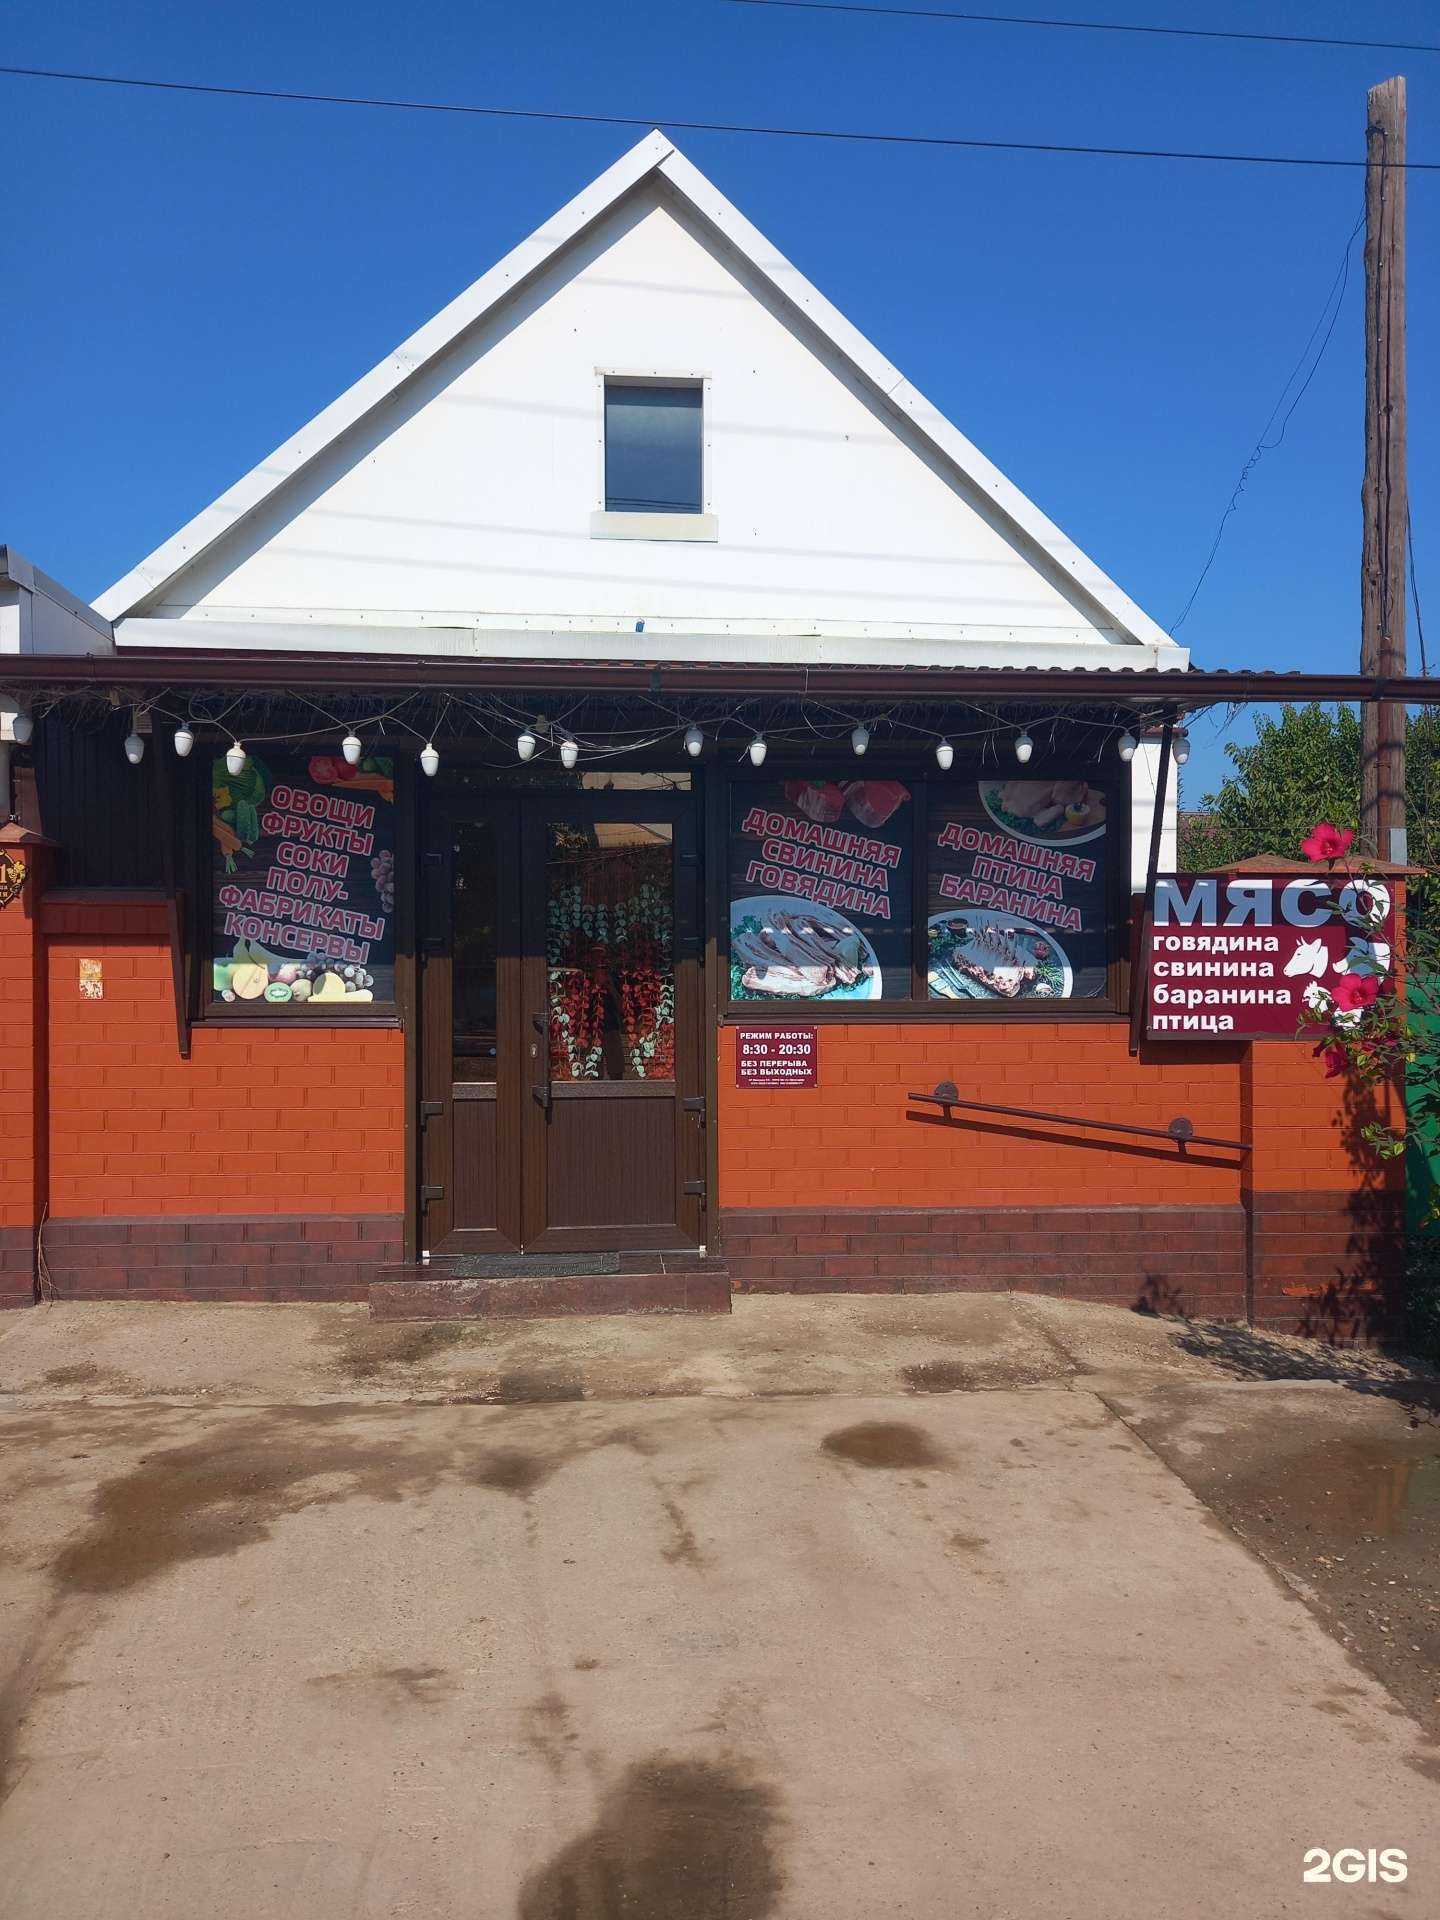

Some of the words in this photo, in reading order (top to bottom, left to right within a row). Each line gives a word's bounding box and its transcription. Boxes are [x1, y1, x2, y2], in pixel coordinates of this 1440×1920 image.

[271, 785, 375, 829] ОВОЩИ
[262, 812, 373, 856] ФРУКТЫ
[742, 807, 902, 868] ДОМАШНЯЯ
[937, 822, 1096, 882] ДОМАШНЯЯ
[276, 842, 349, 878] СОКИ
[762, 839, 889, 892] СВИНИНА
[971, 855, 1063, 899] ПТИЦА
[266, 867, 348, 902] ПОЛУ-
[746, 860, 891, 919] ГОВЯДИНА
[939, 874, 1082, 932] БАРАНИНА
[1153, 879, 1391, 928] МЯСО
[219, 885, 385, 940] ФАБРИКАТЫ
[224, 912, 370, 965] КОНСЕРВЫ
[1153, 935, 1279, 955] говядина
[1153, 961, 1274, 977] свинина
[1153, 983, 1291, 1008] баранина
[1153, 1014, 1234, 1033] птица
[742, 1044, 768, 1055] 8:30
[778, 1044, 811, 1055] 20:30
[760, 1069, 812, 1077] ВЫХОДНЫХ
